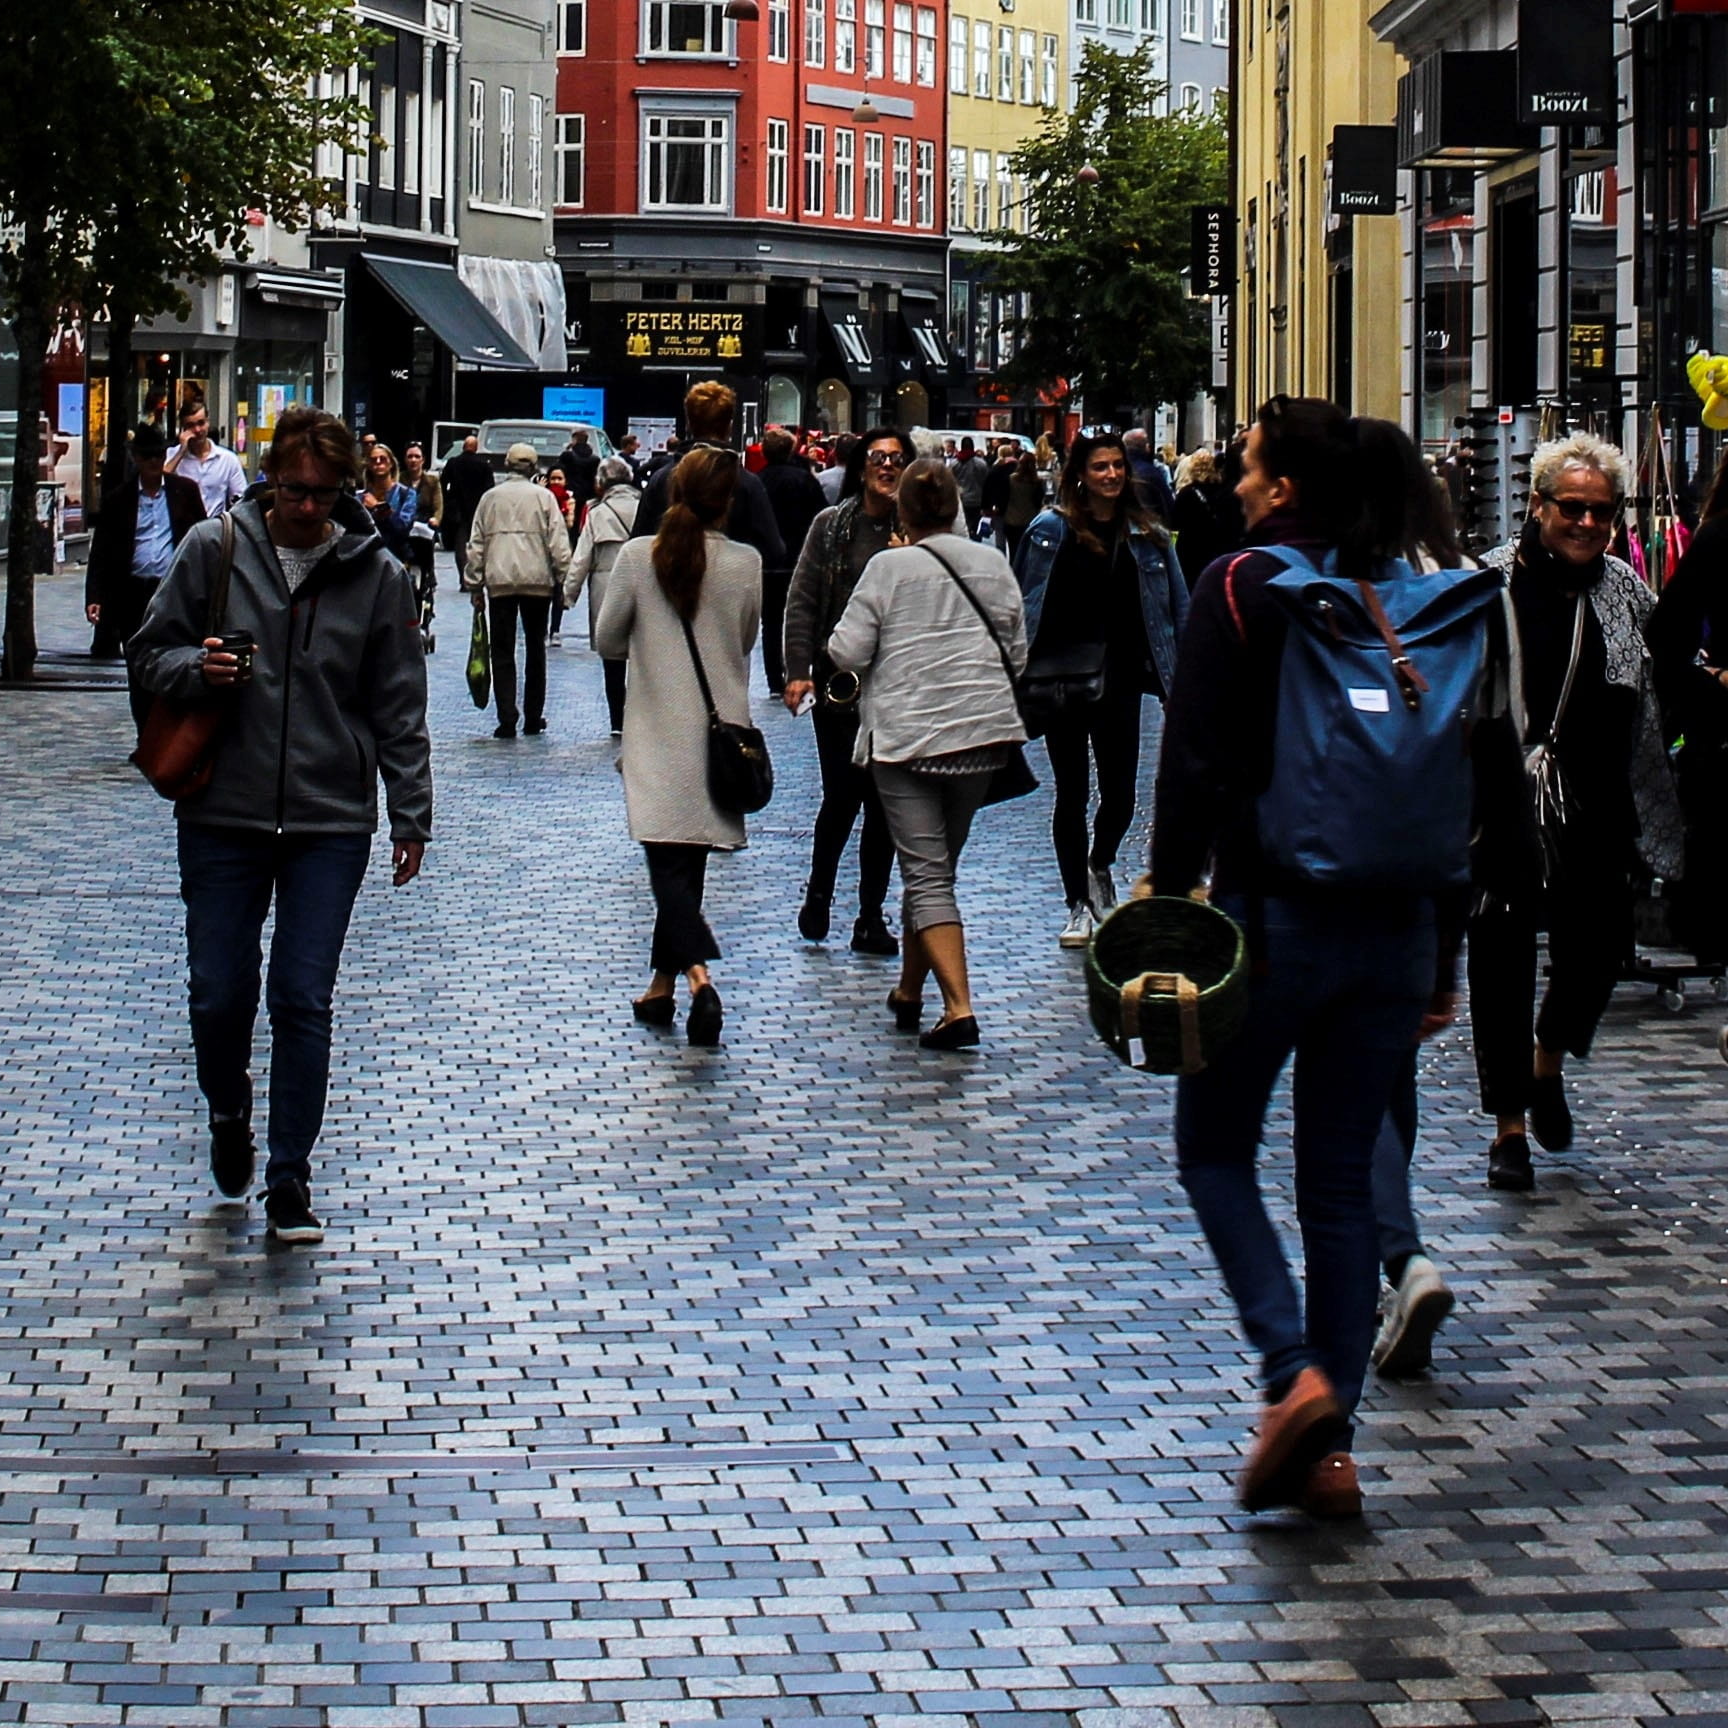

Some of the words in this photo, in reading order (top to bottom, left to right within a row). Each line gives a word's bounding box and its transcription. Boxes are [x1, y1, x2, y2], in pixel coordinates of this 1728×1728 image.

[1532, 94, 1589, 112] Boozt
[1207, 212, 1220, 290] SEPHORA
[626, 312, 684, 331] PETER
[688, 313, 743, 331] HERTZ
